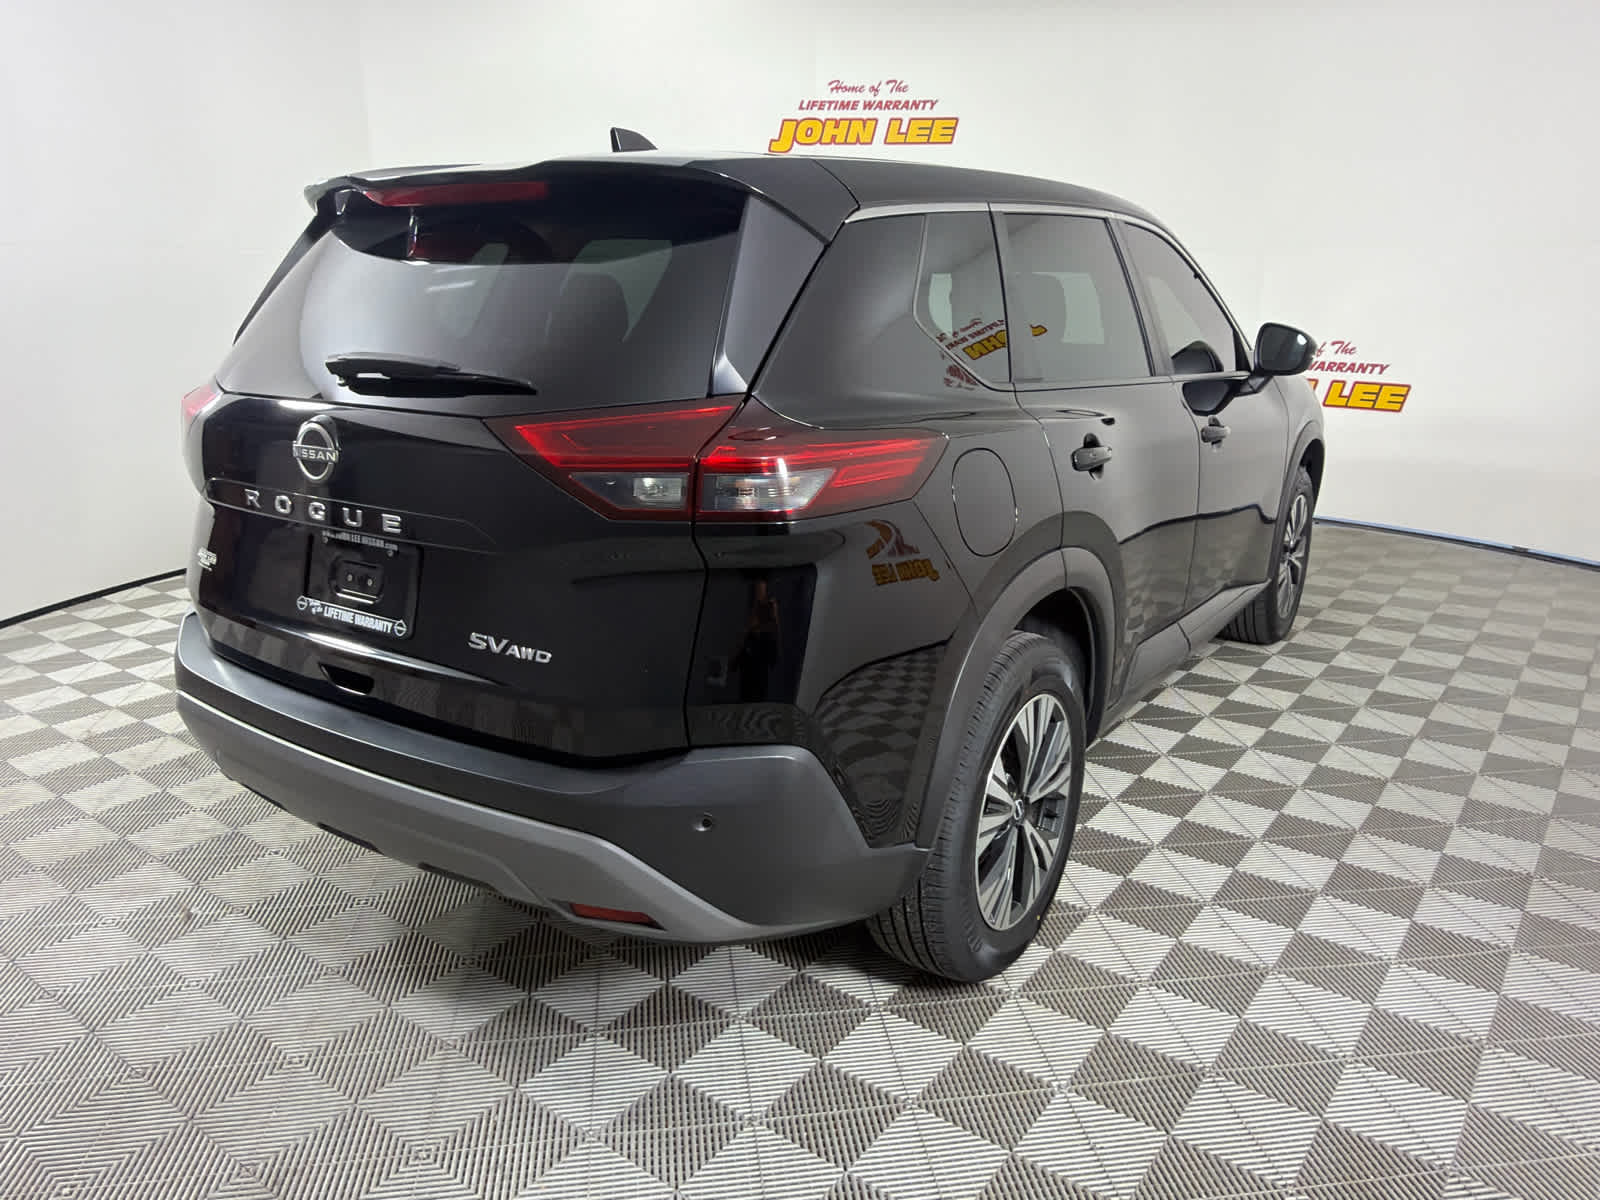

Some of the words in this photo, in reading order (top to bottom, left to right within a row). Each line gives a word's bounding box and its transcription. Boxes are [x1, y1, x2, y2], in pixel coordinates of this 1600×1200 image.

[828, 79, 865, 94] Home
[868, 81, 882, 97] of
[886, 79, 909, 94] The
[798, 99, 860, 111] LIFETIME
[862, 99, 938, 111] WARRANTY
[768, 118, 878, 154] JOHN
[884, 117, 959, 145] LEE
[1331, 340, 1357, 355] The
[1322, 379, 1412, 413] LEE
[292, 445, 337, 463] NISSAN
[244, 488, 403, 534] ROGUE
[323, 606, 354, 624] LIFETIME
[354, 614, 393, 633] WARRANTY
[468, 632, 509, 654] SV
[505, 645, 553, 664] AWD
